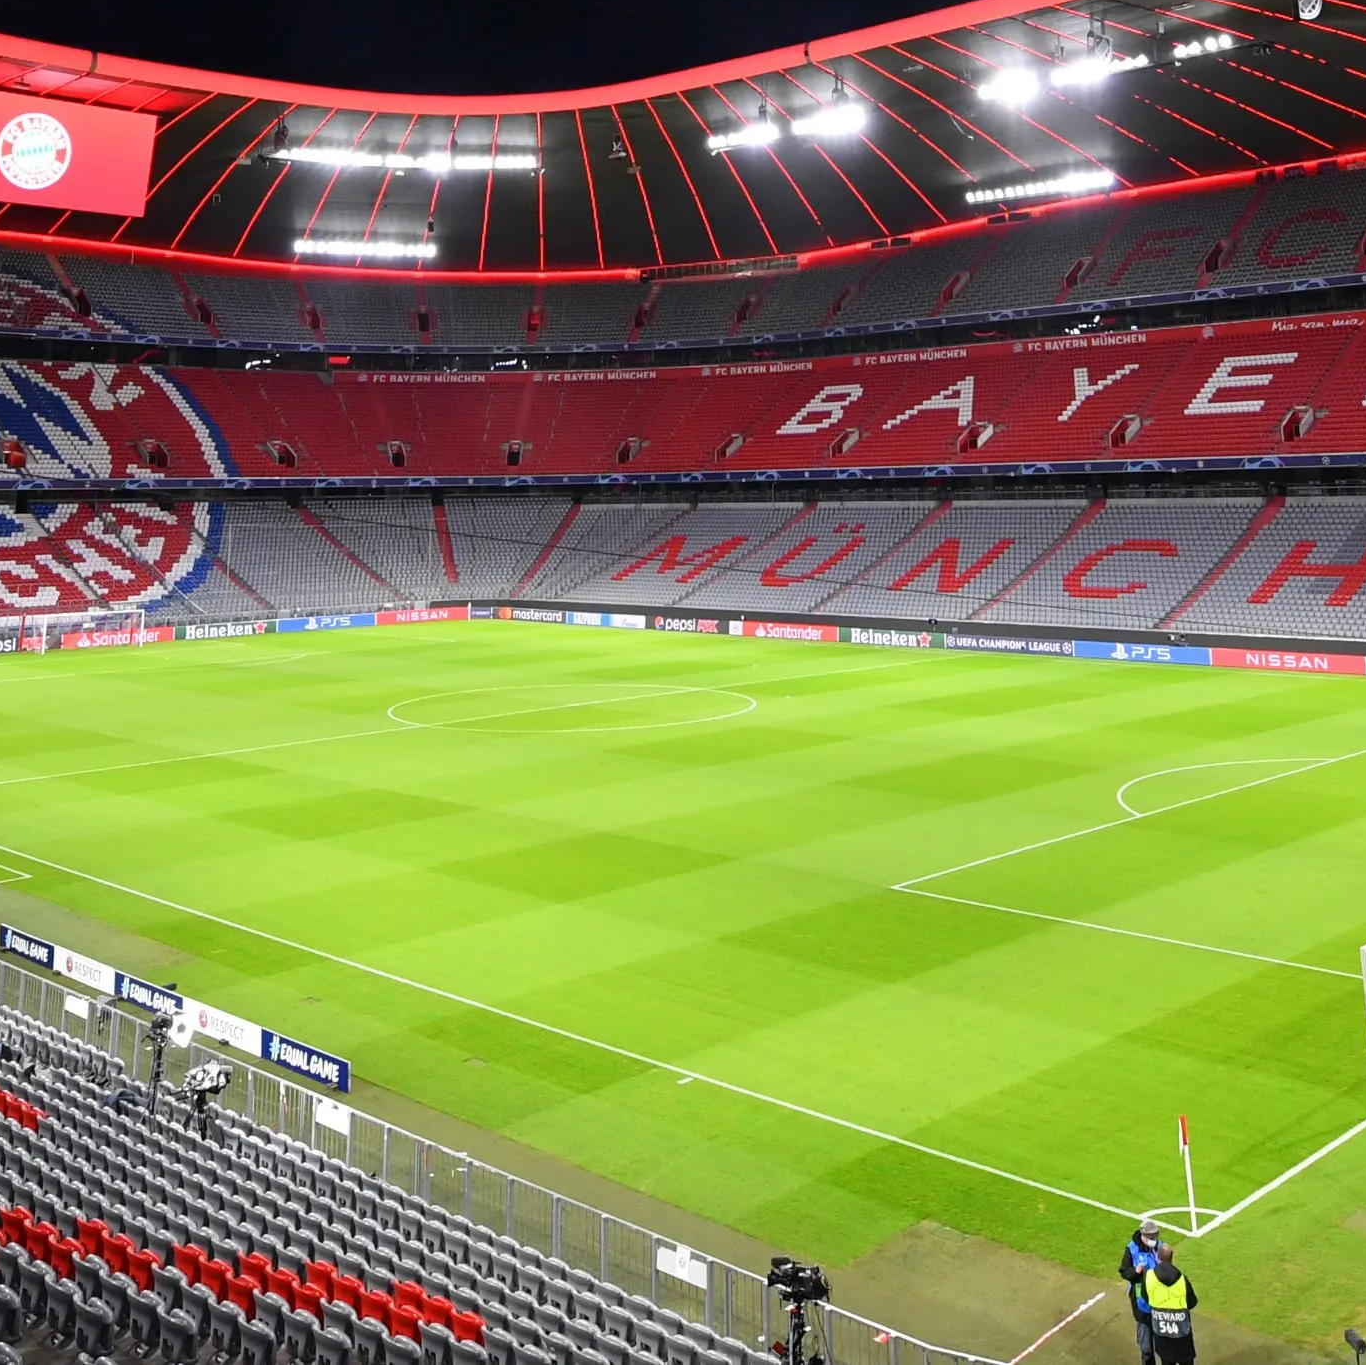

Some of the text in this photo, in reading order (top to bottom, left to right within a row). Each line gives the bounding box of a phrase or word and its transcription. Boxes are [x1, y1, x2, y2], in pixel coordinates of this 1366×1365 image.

[1106, 206, 1347, 287] FC
[1028, 333, 1146, 351] FC BAYERN MÜNCHEN
[865, 348, 967, 365] FC BAYERN MÜNCHEN
[548, 371, 656, 382] FC BAYERN MÜNCHEN
[715, 362, 813, 376] FC BAYERN MÜNCHEN
[373, 373, 485, 383] FC BAYERN MÜNCHEN
[321, 616, 350, 627] PS5
[396, 610, 448, 622] NISSAN
[512, 609, 563, 622] mastercard
[185, 623, 253, 640] Heineken
[665, 617, 720, 633] pepsi MAX
[766, 624, 823, 641] Santander
[92, 630, 161, 647] Santander
[851, 628, 918, 647] Heineken
[956, 637, 1061, 653] UEFA CHAMPIONS LEAGUE
[1131, 647, 1171, 660] PS5
[1246, 653, 1329, 669] NISSAN
[5, 929, 49, 964] #EQUAL GAME
[75, 961, 102, 983] RESPECT
[121, 976, 176, 1015] #EQUAL GAME
[210, 1015, 245, 1042] RESPECT
[269, 1035, 339, 1082] #EQUAL GAME
[1159, 1321, 1179, 1334] 564
